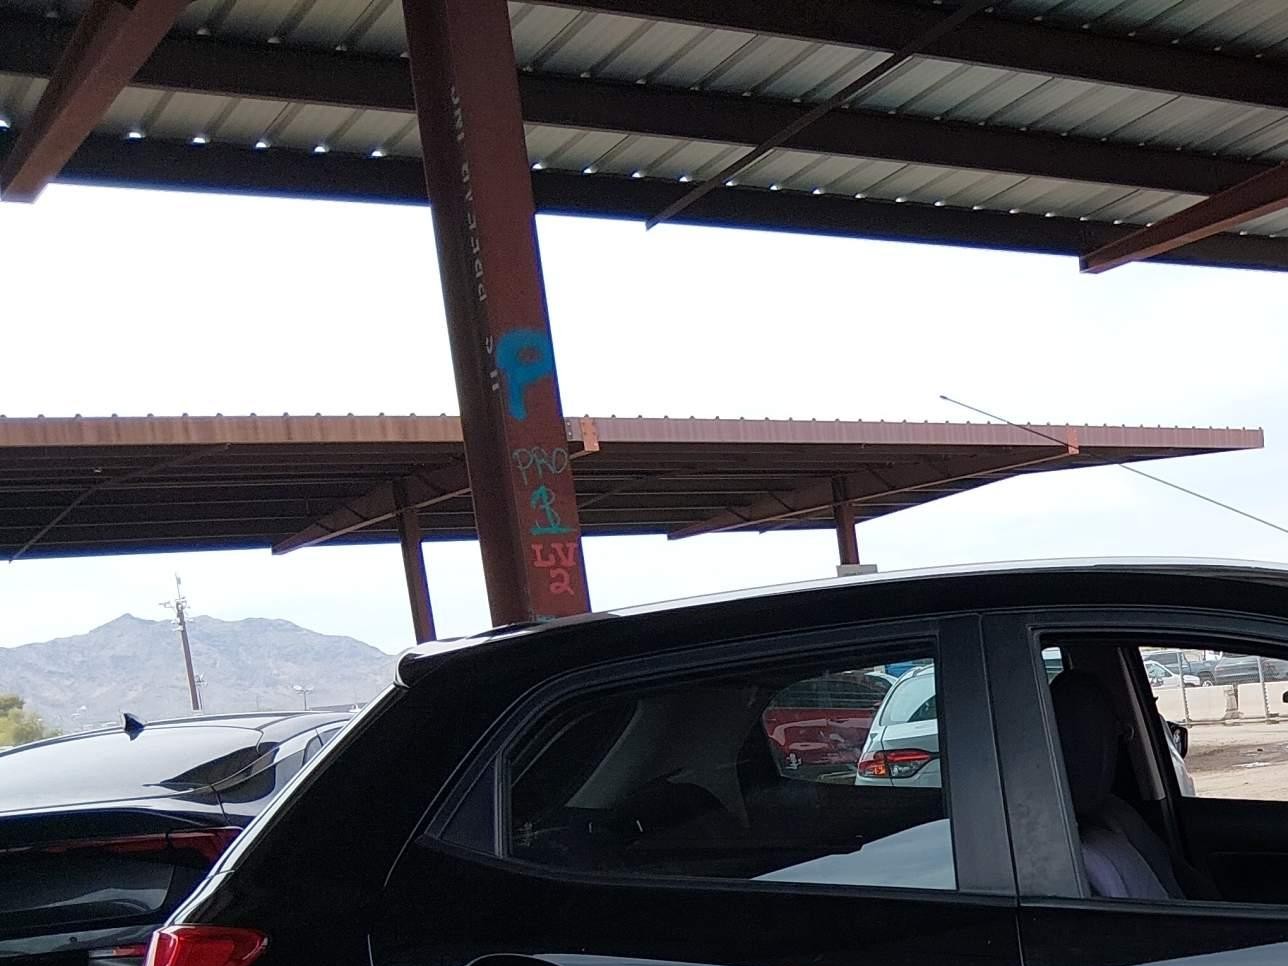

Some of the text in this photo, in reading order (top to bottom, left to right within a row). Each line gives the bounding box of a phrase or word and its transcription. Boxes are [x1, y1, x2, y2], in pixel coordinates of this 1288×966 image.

[496, 328, 554, 422] P
[531, 541, 578, 569] LV
[550, 567, 575, 596] 2
